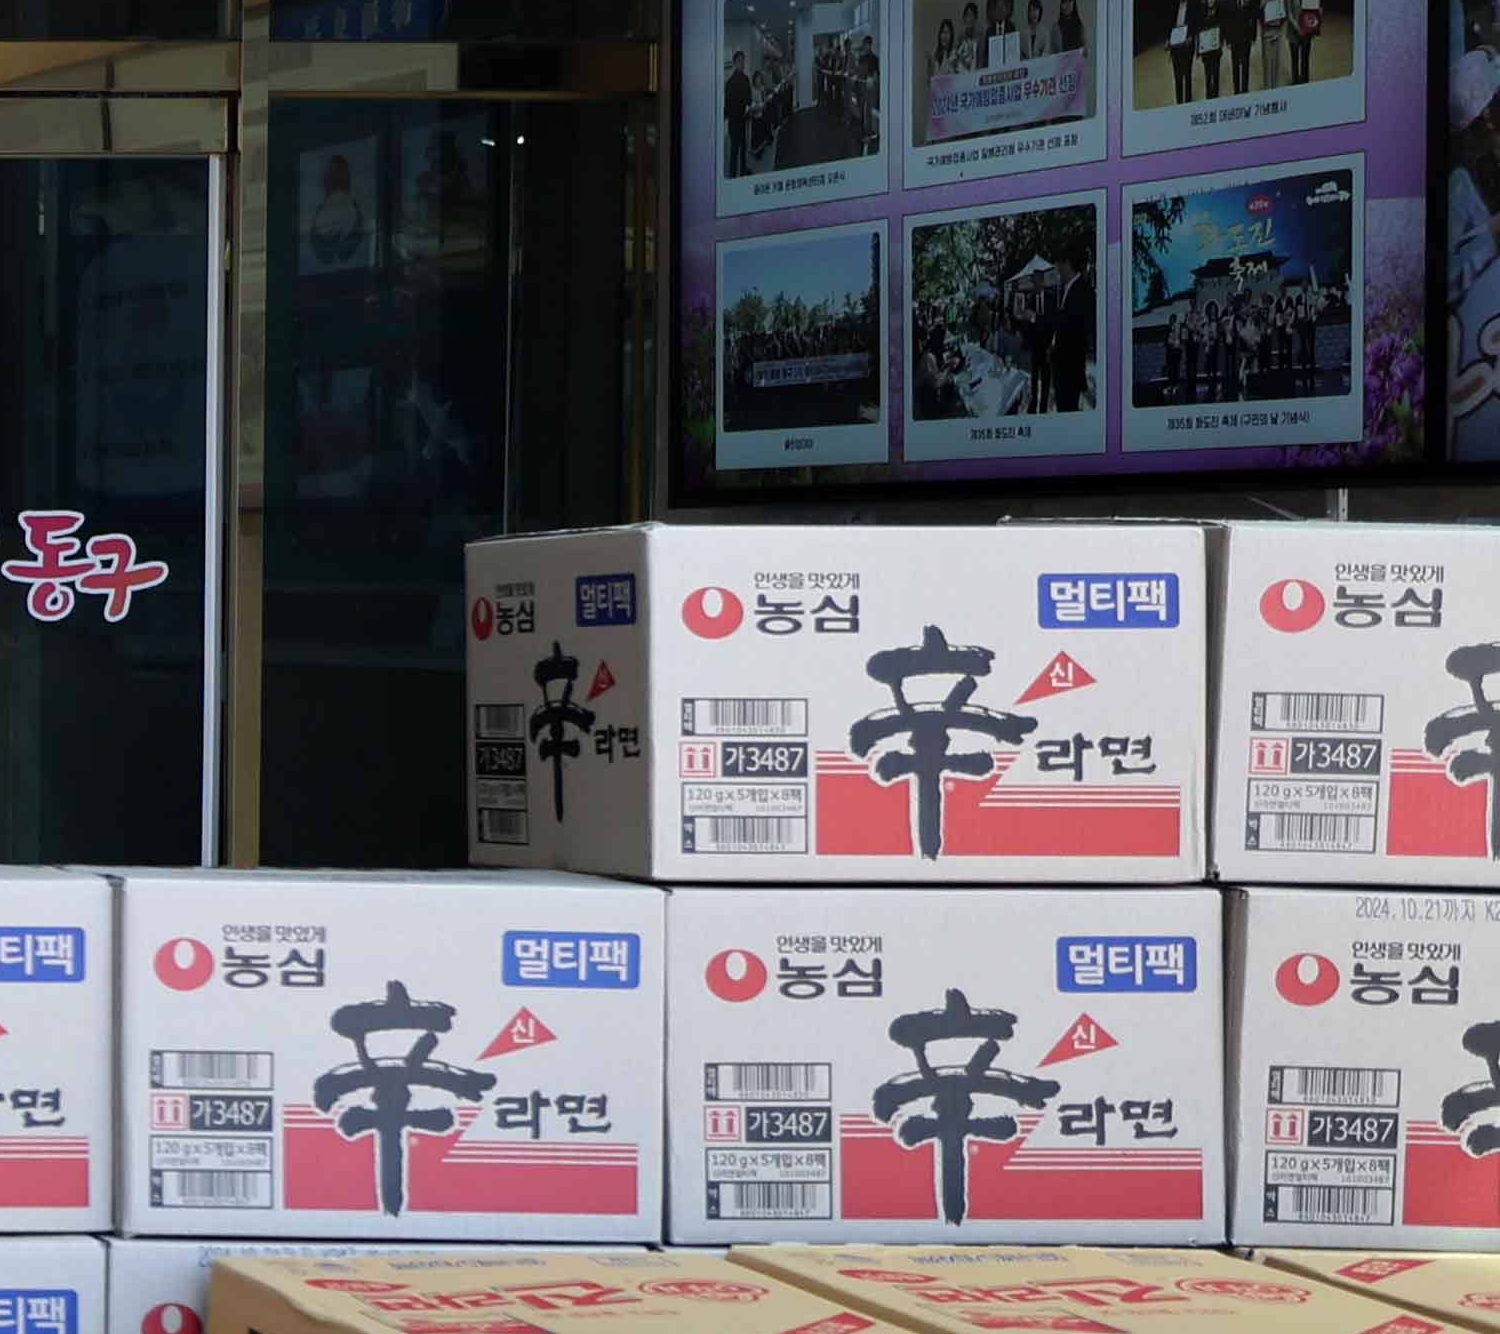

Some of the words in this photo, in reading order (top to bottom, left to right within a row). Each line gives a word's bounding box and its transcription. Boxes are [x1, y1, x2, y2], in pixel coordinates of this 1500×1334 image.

[1, 510, 168, 623] 동구
[754, 594, 860, 636] 농심
[1049, 579, 1166, 622] 멀티팩
[1049, 663, 1074, 687] 신
[725, 746, 803, 775] 가3487
[849, 625, 1038, 861] 辛
[1035, 733, 1156, 782] 라면
